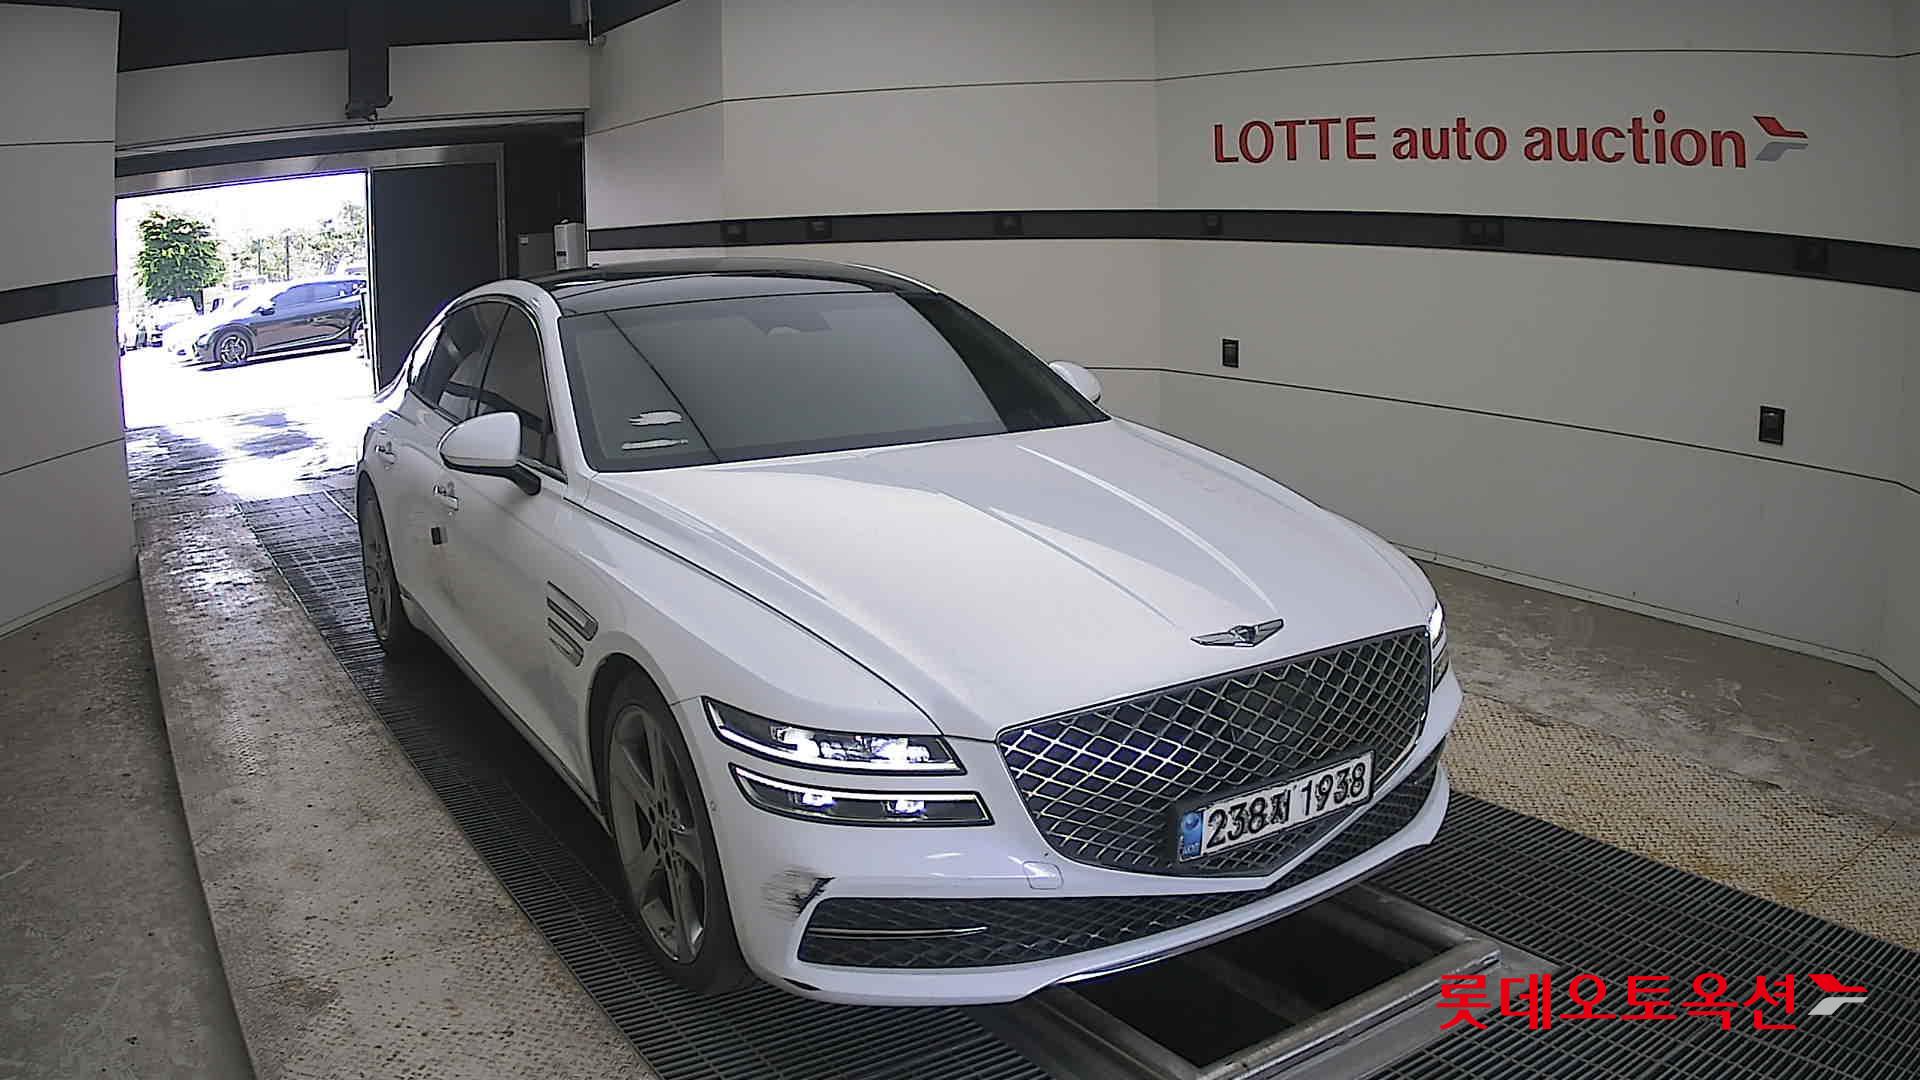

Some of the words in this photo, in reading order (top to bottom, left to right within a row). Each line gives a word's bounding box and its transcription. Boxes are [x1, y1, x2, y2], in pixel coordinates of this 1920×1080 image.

[1213, 115, 1377, 163] LOTTE
[1392, 117, 1508, 161] auto
[1523, 109, 1746, 168] auction
[1301, 762, 1367, 816] 1938
